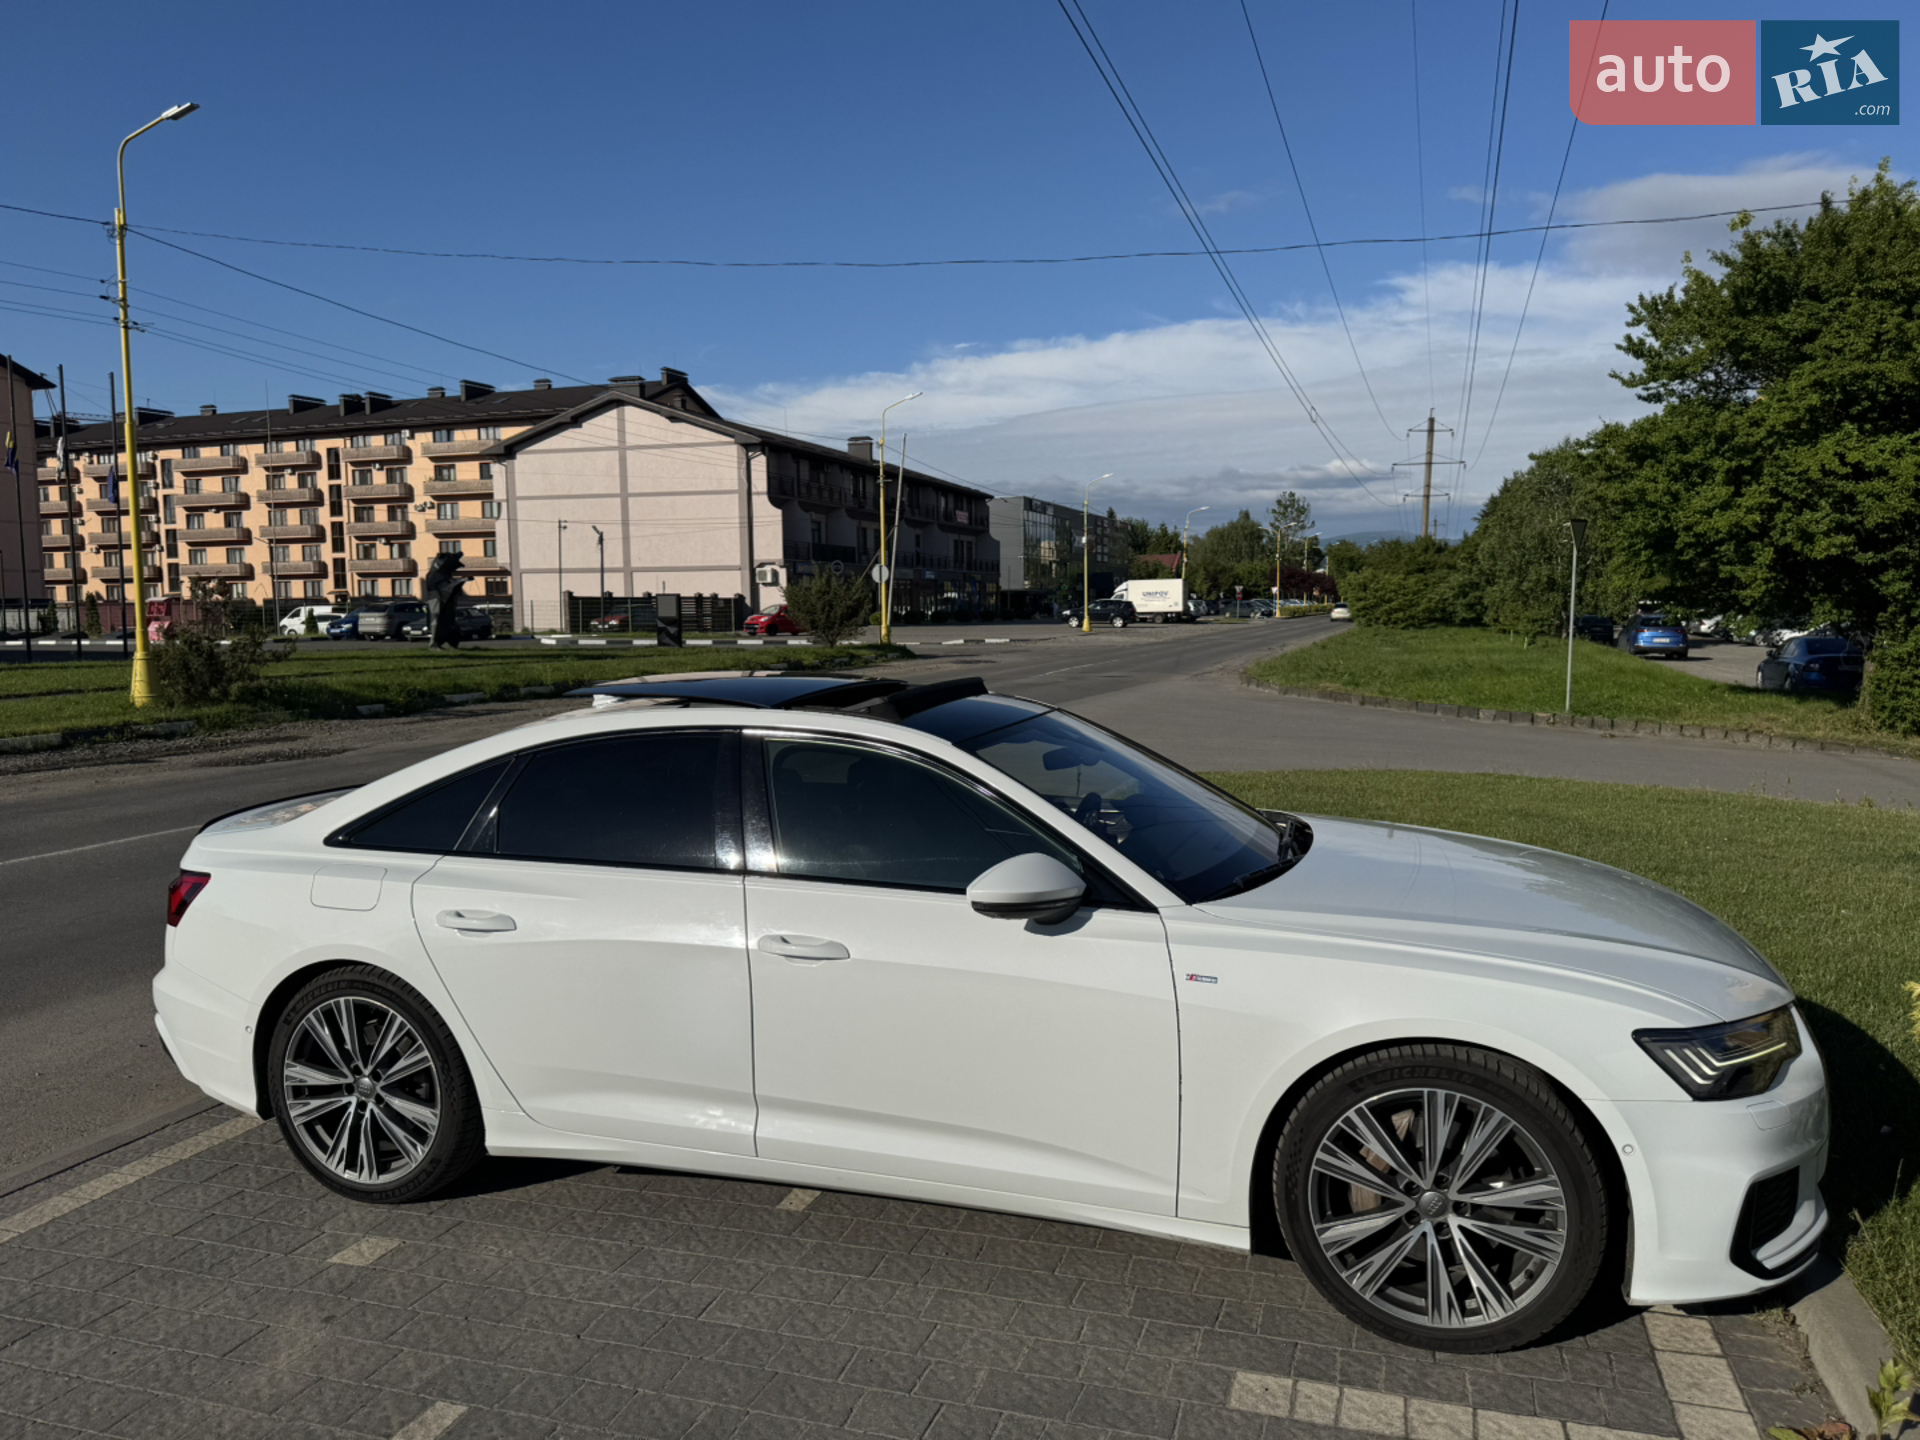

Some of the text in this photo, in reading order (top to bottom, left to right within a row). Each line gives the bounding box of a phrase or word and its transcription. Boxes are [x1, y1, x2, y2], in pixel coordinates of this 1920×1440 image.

[294, 980, 348, 1011] MICHELIN
[1374, 1066, 1476, 1085] MICHELIN
[372, 1170, 429, 1200] MICHELIN
